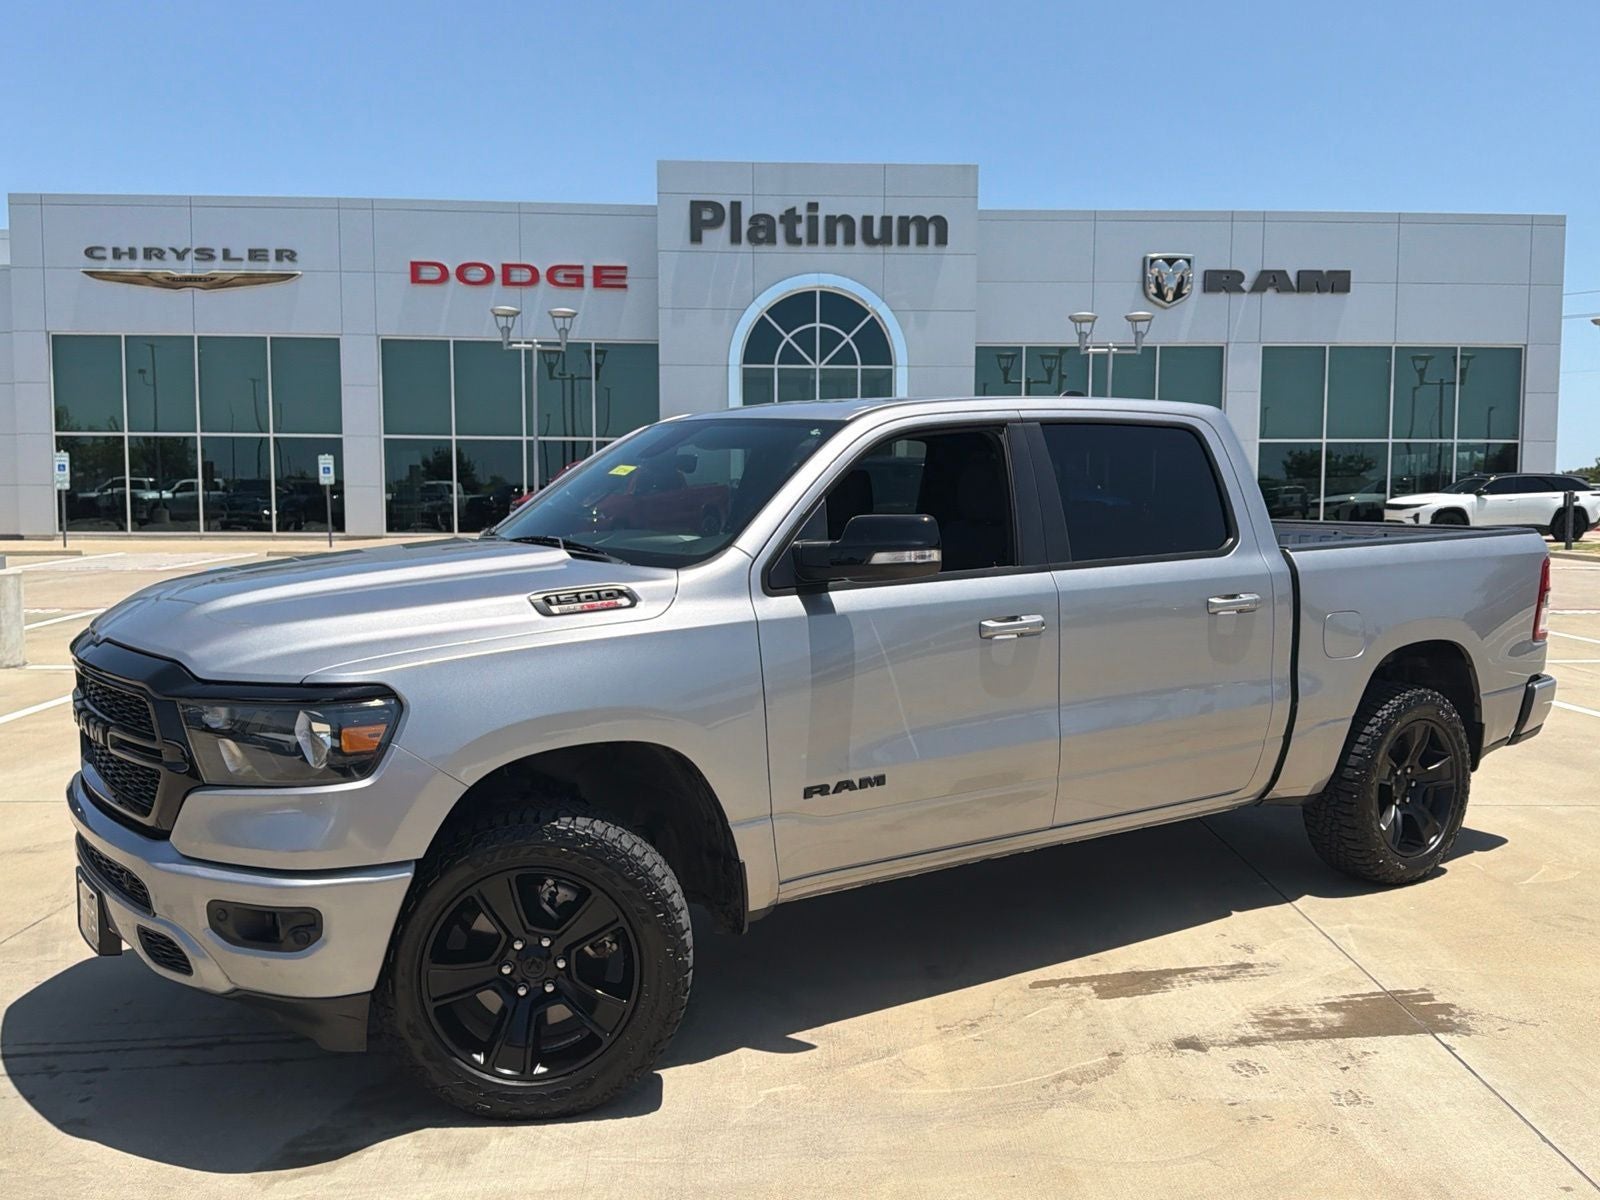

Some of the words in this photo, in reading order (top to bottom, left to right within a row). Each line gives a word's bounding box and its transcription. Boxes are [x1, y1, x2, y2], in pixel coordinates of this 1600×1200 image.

[690, 200, 949, 246] Platinum
[84, 246, 298, 262] CHRYSLER
[410, 261, 628, 289] DODGE
[1204, 269, 1351, 293] RAM
[545, 589, 620, 605] 1500
[803, 774, 886, 800] RAM
